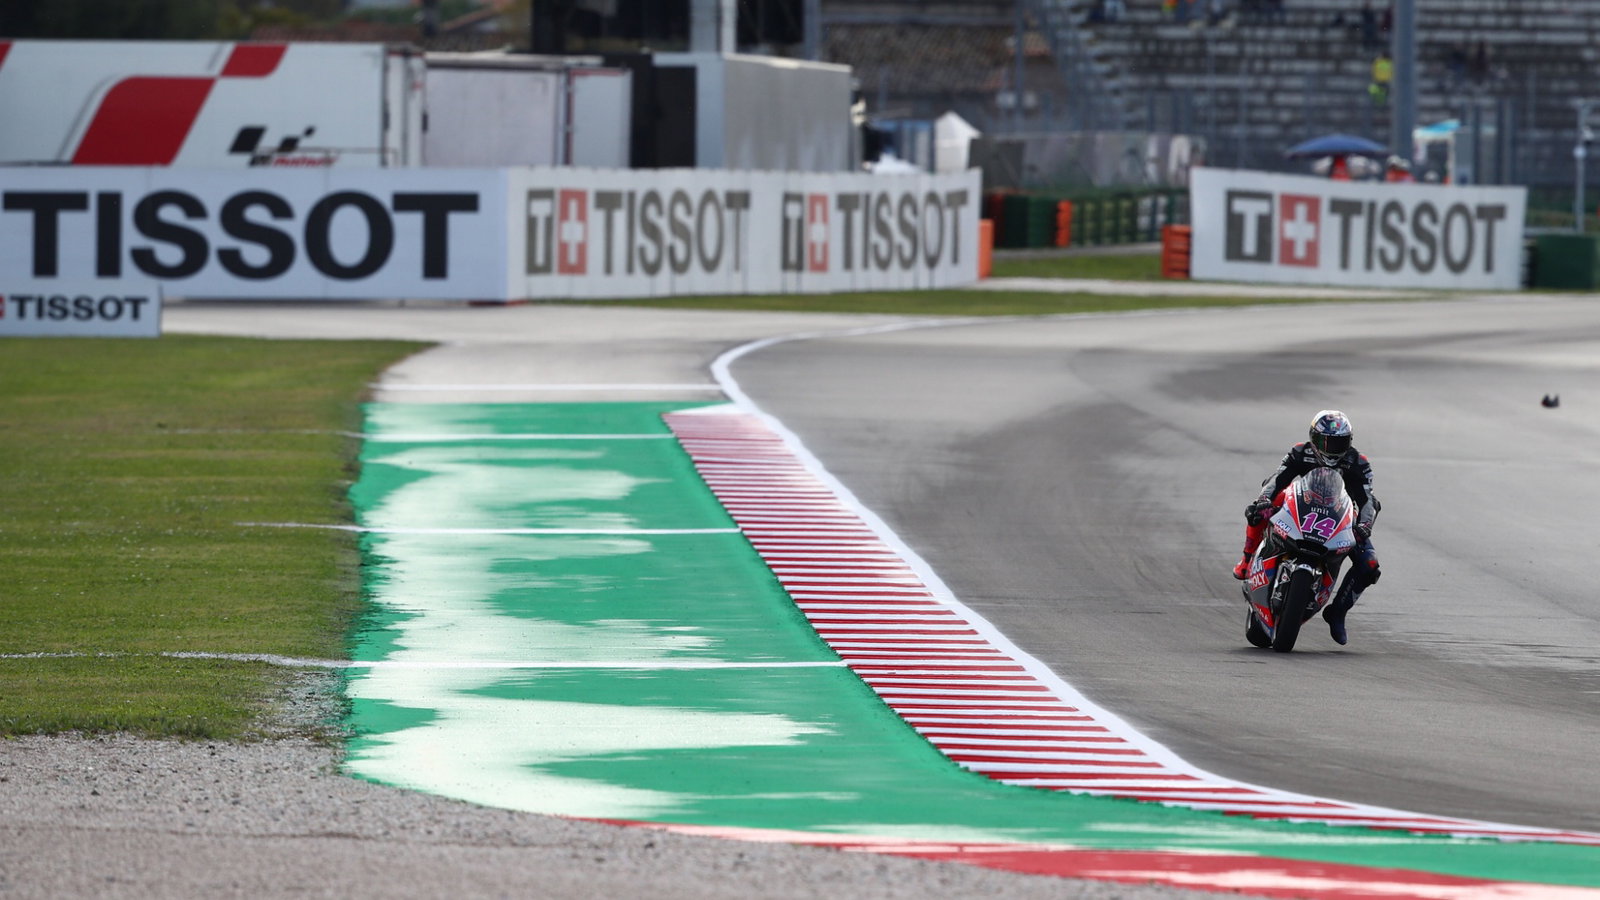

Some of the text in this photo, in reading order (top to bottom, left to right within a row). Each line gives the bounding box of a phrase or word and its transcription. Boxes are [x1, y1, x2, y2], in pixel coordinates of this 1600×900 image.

[3, 190, 479, 280] TISSOT
[594, 188, 750, 277] TISSOT
[837, 189, 968, 271] TISSOT
[1330, 198, 1506, 274] TISSOT
[10, 295, 148, 321] TISSOT
[1301, 512, 1336, 539] 14
[1311, 505, 1329, 516] unit
